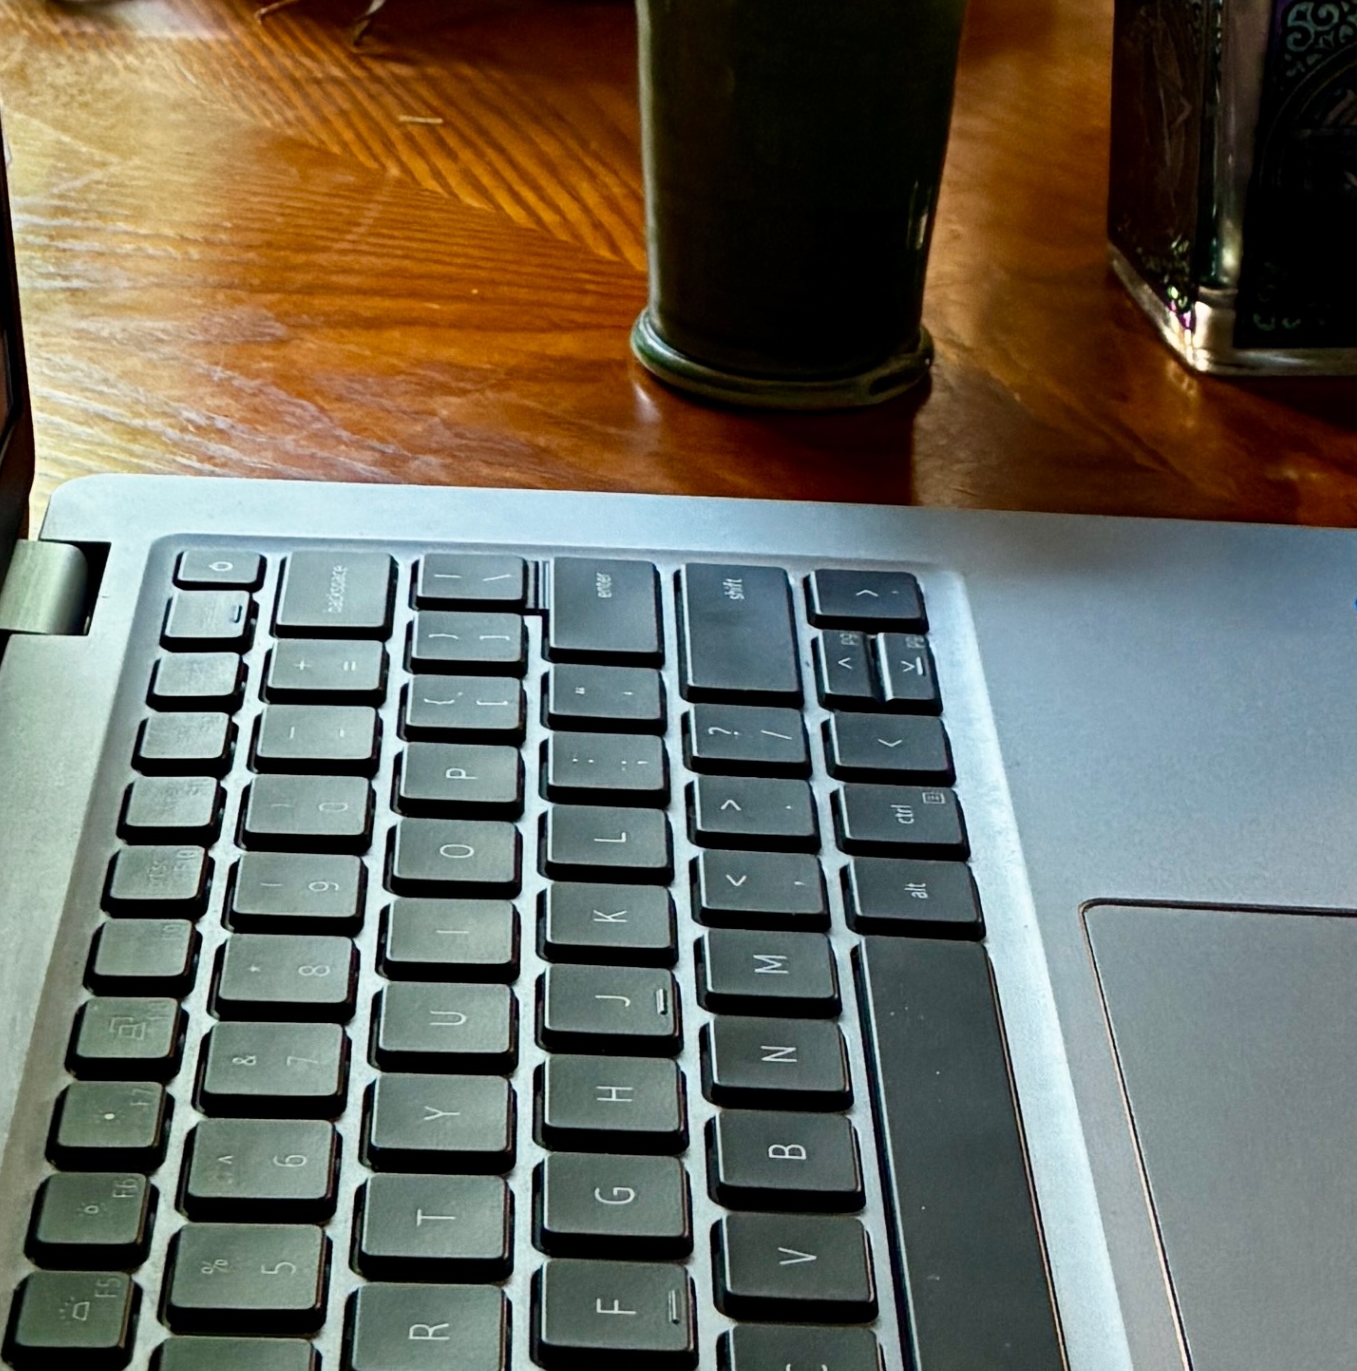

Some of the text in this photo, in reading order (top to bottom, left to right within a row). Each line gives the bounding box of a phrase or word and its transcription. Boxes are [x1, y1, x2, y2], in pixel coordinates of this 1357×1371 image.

[596, 573, 612, 597] enter
[724, 577, 744, 601] shift
[446, 769, 477, 779] P
[319, 803, 348, 812] 0
[891, 805, 914, 824] ctrl
[595, 832, 626, 842] L
[440, 845, 474, 858] O
[308, 881, 340, 892] 9
[905, 884, 928, 898] alt
[594, 911, 627, 922] K
[299, 966, 330, 977] 8
[753, 955, 788, 973] M
[596, 996, 630, 1007] J
[431, 1011, 467, 1025] U
[761, 1046, 797, 1062] N
[597, 1087, 633, 1102] H
[424, 1107, 460, 1120] Y
[769, 1145, 806, 1160] B
[274, 1155, 307, 1167] 6
[113, 1179, 137, 1197] F6
[595, 1187, 635, 1204] G
[417, 1210, 455, 1225] T
[778, 1248, 816, 1264] V
[262, 1262, 296, 1274] 5
[95, 1278, 121, 1297] F5
[597, 1299, 636, 1314] F
[409, 1324, 449, 1340] R
